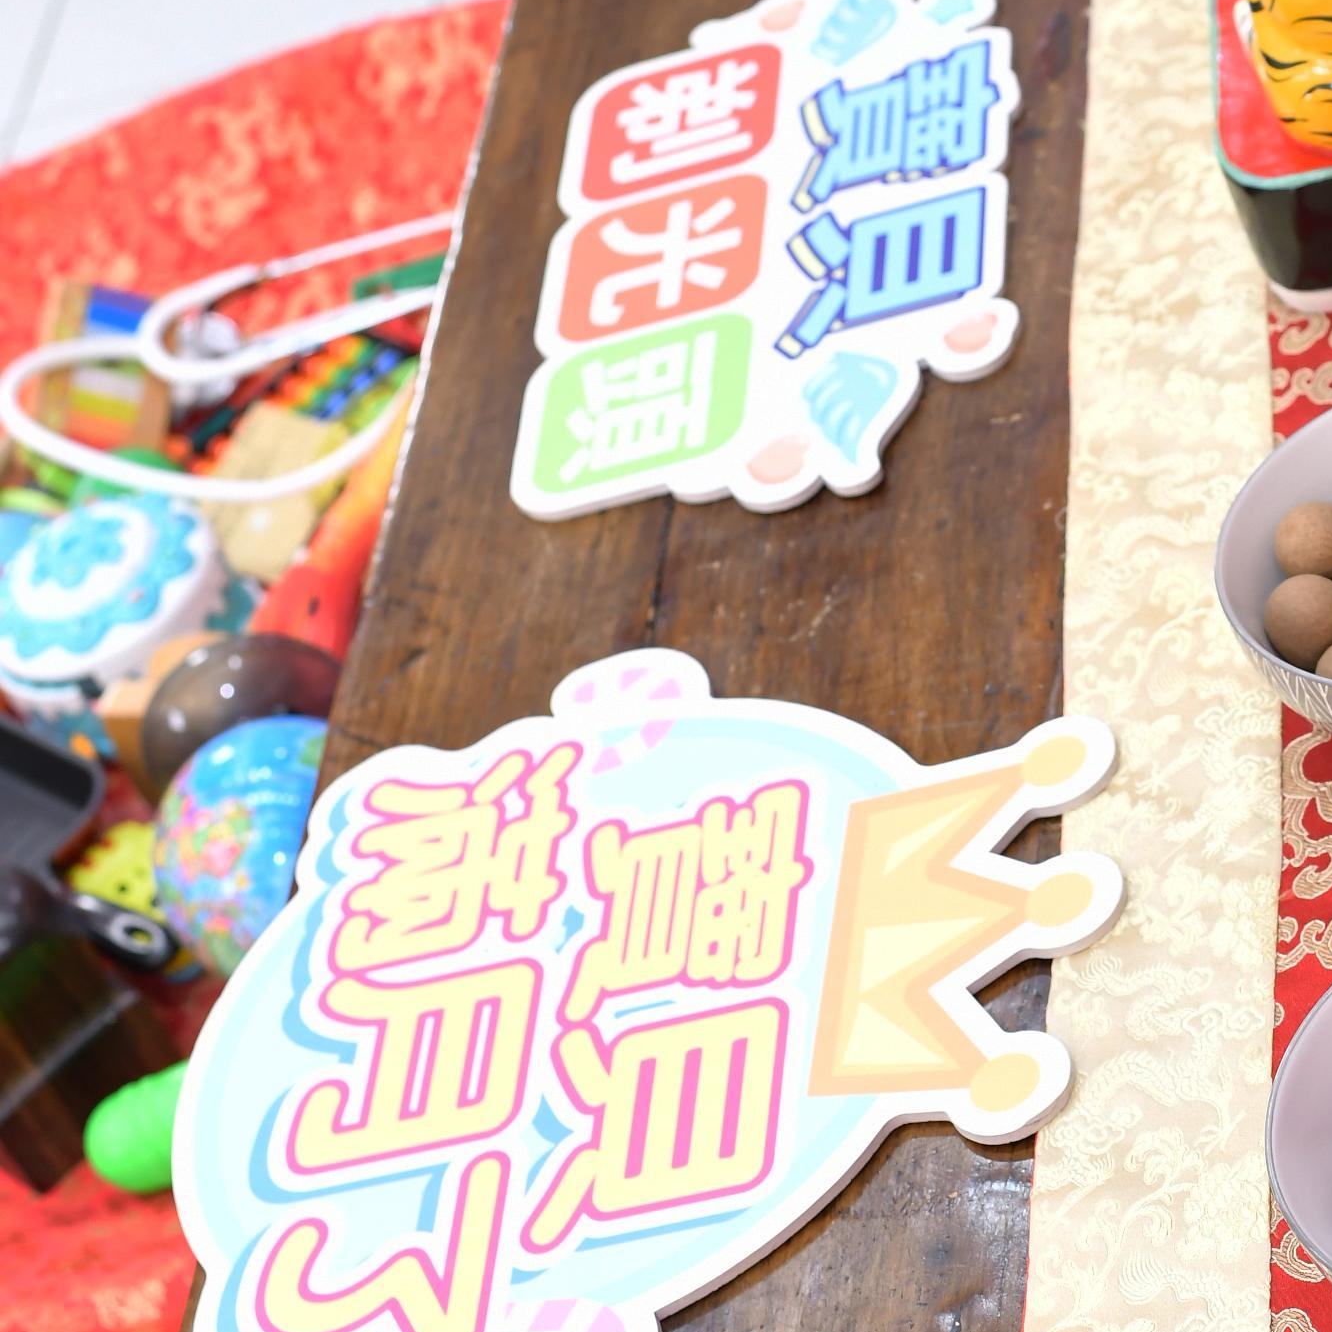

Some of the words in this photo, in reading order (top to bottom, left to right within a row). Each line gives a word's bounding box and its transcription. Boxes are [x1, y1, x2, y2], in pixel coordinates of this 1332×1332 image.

[558, 60, 759, 483] 剃光頭
[773, 39, 1001, 359] 寶貝
[518, 777, 814, 1255] 寶貝
